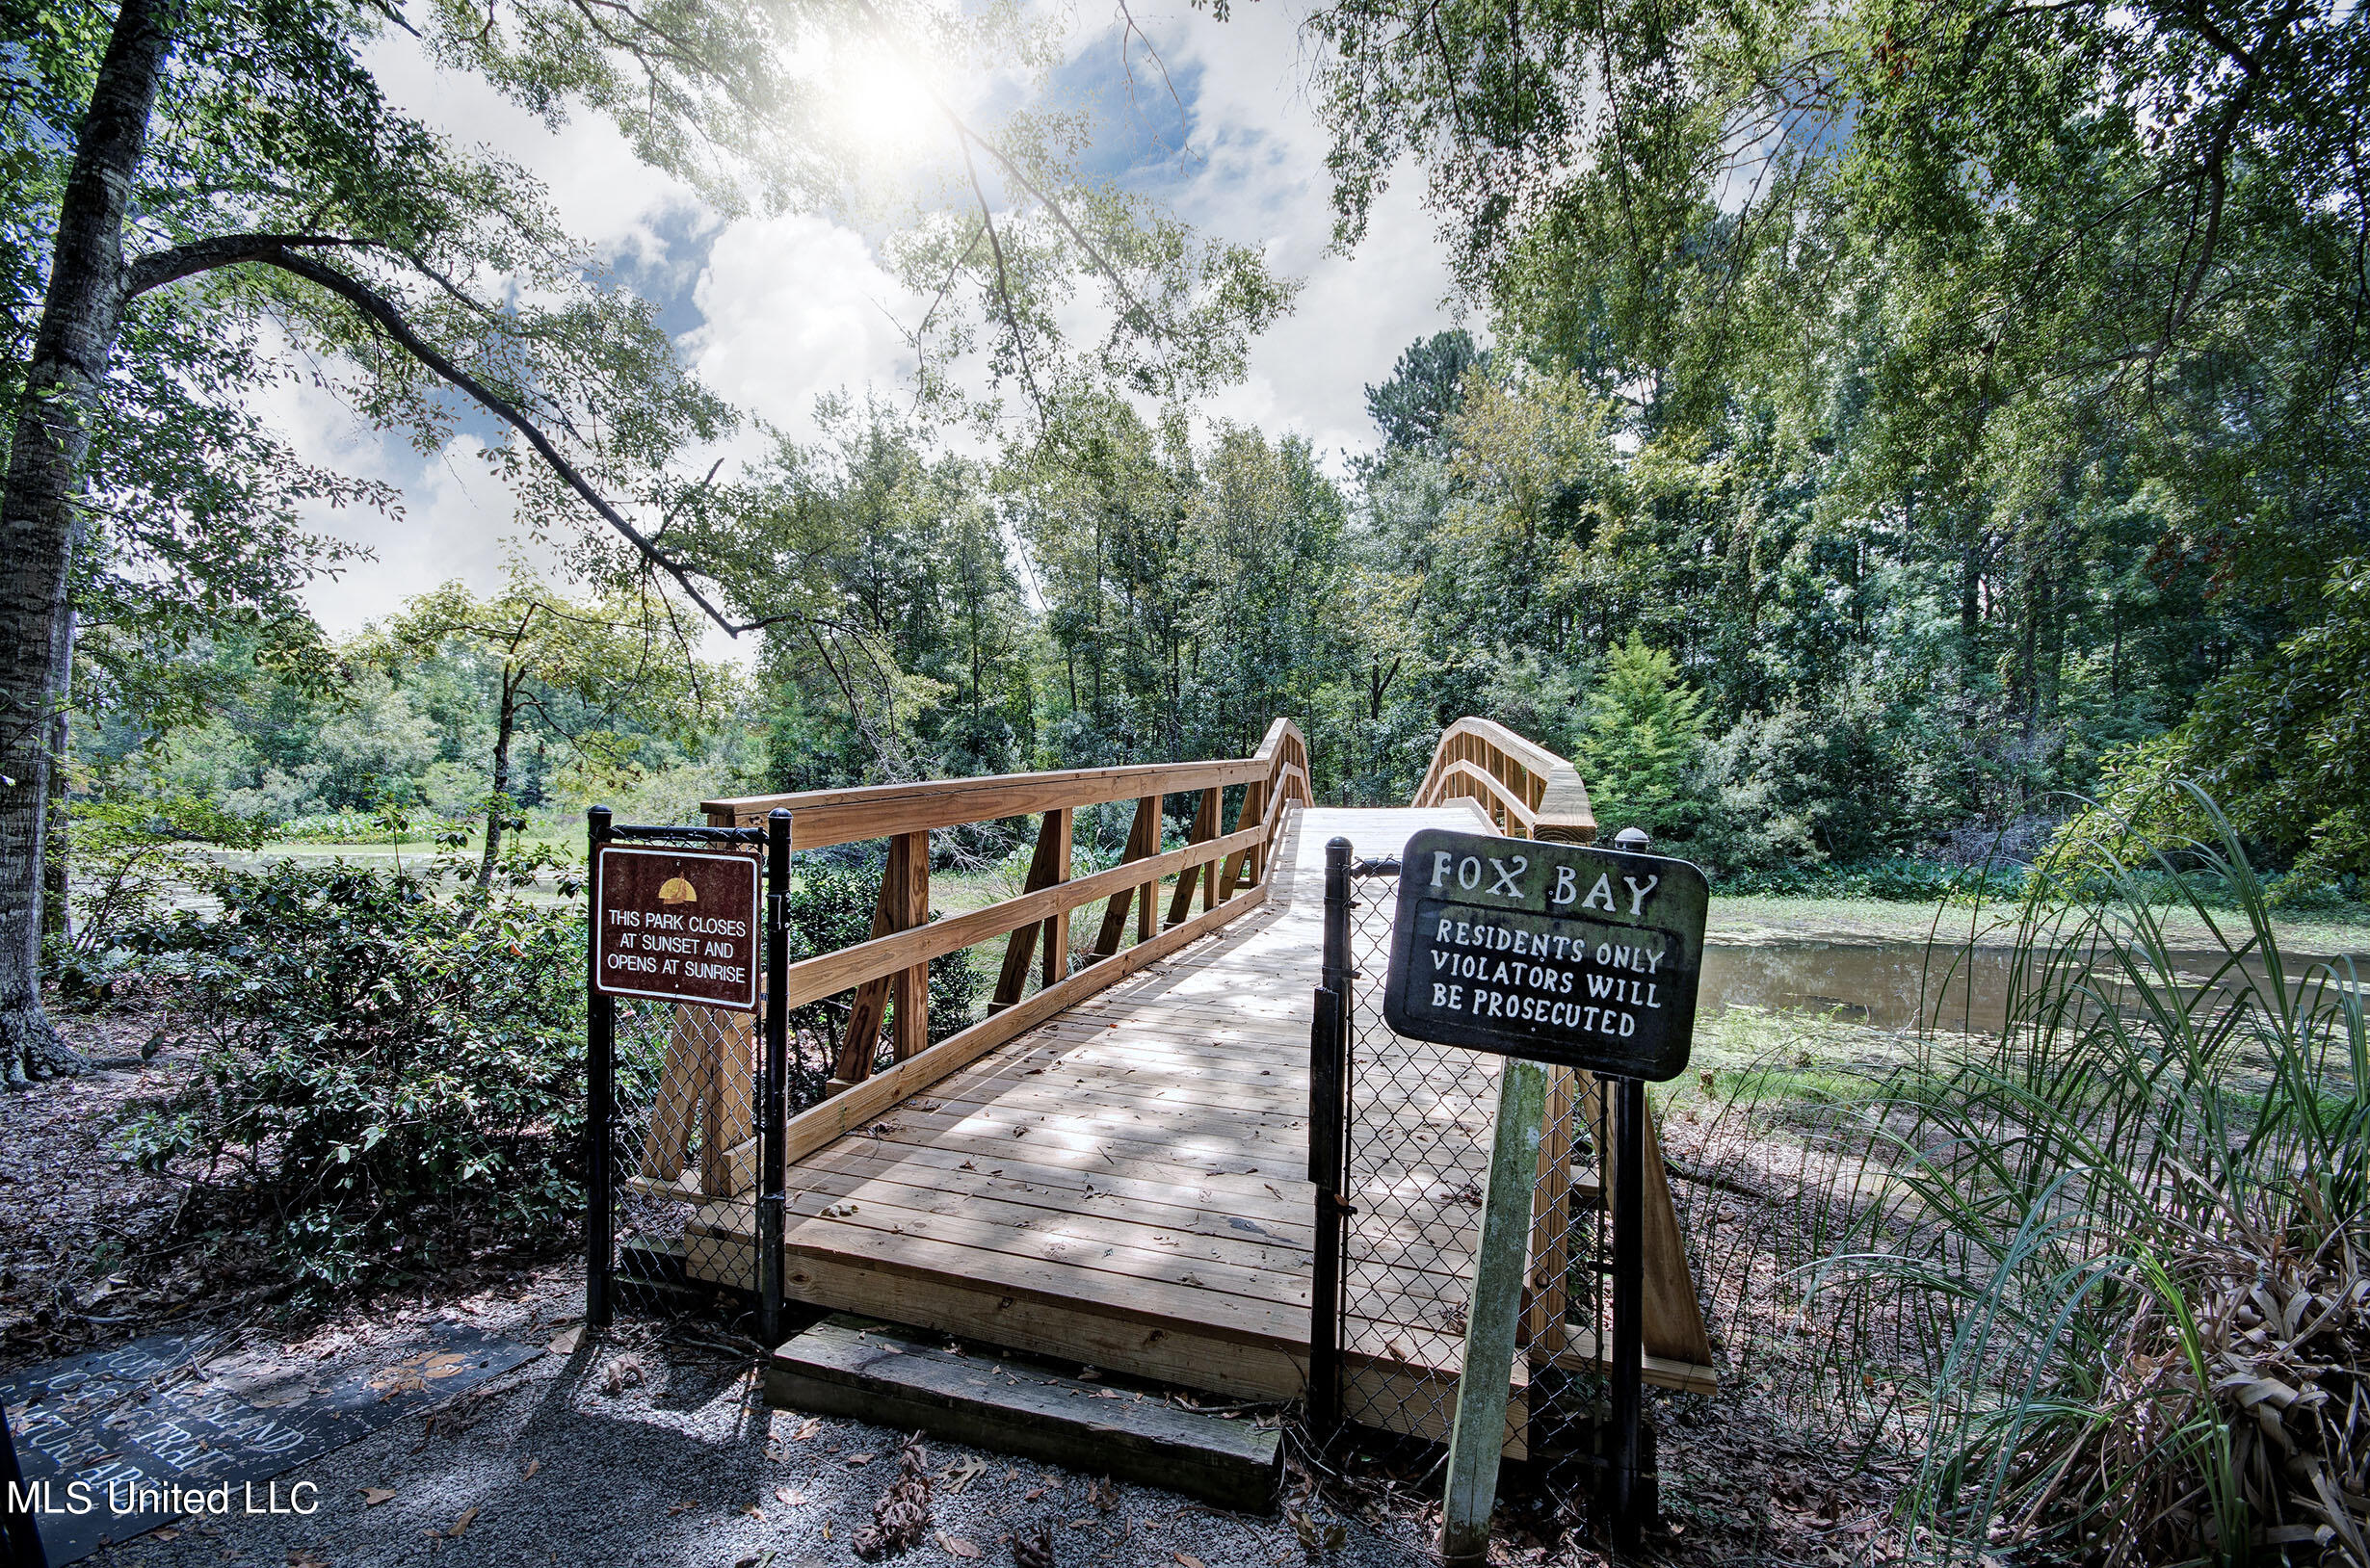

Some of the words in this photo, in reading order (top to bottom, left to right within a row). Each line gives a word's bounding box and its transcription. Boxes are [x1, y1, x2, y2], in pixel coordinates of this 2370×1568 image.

[1430, 849, 1529, 899] FOX
[1552, 865, 1659, 916] BAY
[608, 909, 640, 928] THIS
[645, 912, 683, 930] PARK
[689, 917, 746, 937] CLOSES
[619, 933, 637, 949] AT
[642, 934, 699, 954] SUNSET
[704, 942, 733, 959] AND
[1435, 919, 1586, 963] RESIDENTS
[1595, 942, 1666, 975] ONLY
[608, 954, 656, 973] OPENS
[662, 959, 679, 975] AT
[685, 961, 746, 983] SUNRISE
[1431, 950, 1574, 994] VIOLATORS
[1587, 974, 1662, 1008] WILL
[1432, 982, 1462, 1010] BE
[1472, 989, 1636, 1037] PROSECUTED
[96, 1346, 162, 1376] FOX
[30, 1368, 155, 1429] JOGGNG
